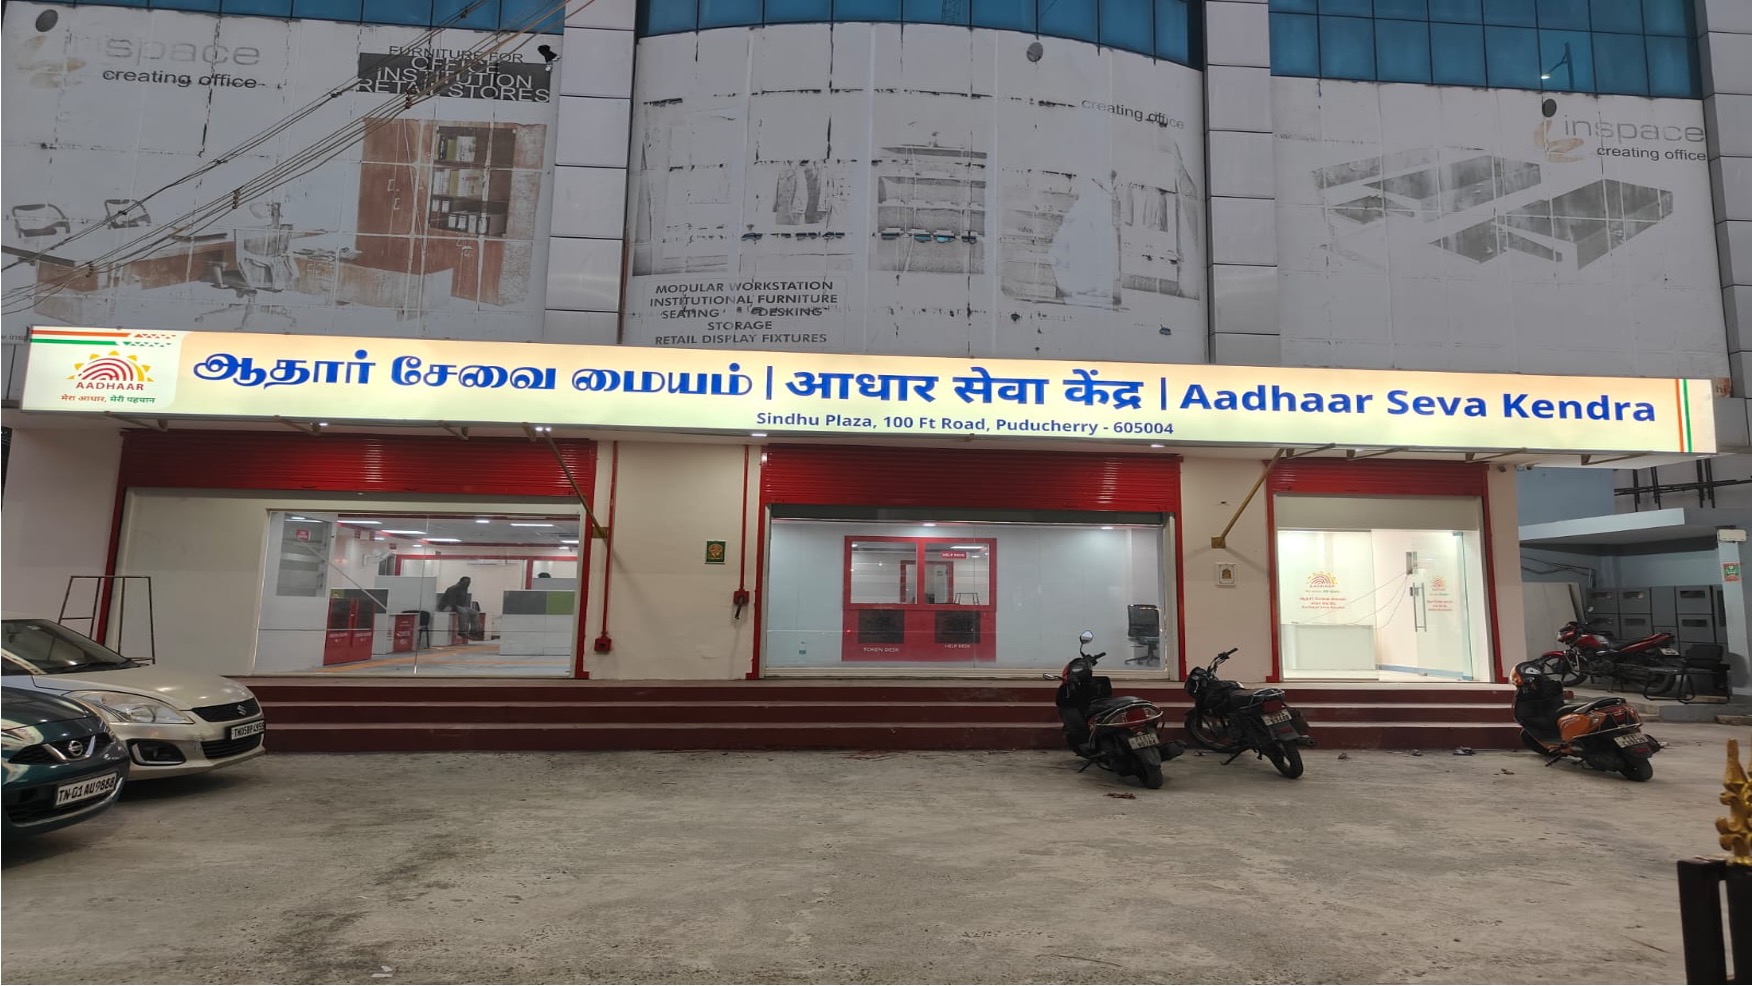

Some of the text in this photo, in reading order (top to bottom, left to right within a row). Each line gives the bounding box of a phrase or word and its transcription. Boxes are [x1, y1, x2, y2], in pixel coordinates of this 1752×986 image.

[78, 36, 261, 66] space
[489, 53, 524, 63] FOR
[102, 69, 257, 88] creating office
[448, 84, 550, 102] STORES
[1081, 99, 1144, 122] creating
[1564, 114, 1705, 143] inspace
[1596, 147, 1707, 161] creating office
[655, 281, 833, 294] MODULAR WORKSTATION
[650, 294, 838, 307] INSTITUTIONAL FURNITURE
[661, 307, 823, 319] SEATING DESKING
[707, 320, 772, 331] STORAGE
[655, 333, 828, 345] RETAIL DISPLAY FIXTURES
[193, 349, 753, 396] ஆதார் சேவை மையம்
[75, 381, 145, 391] AADHAAR
[785, 366, 1144, 410] आधार सेवा केंद्र
[61, 393, 76, 401] मेरा
[110, 394, 125, 402] मेरी
[1179, 384, 1656, 422] Aadhaar Seva Kendra
[756, 412, 819, 426] Sindhu
[825, 414, 877, 429] Plaza,
[883, 416, 914, 428] 100
[919, 417, 936, 429] Ft
[941, 418, 990, 432] Road,
[996, 419, 1098, 435] Puducherry
[1113, 421, 1174, 434] 605004
